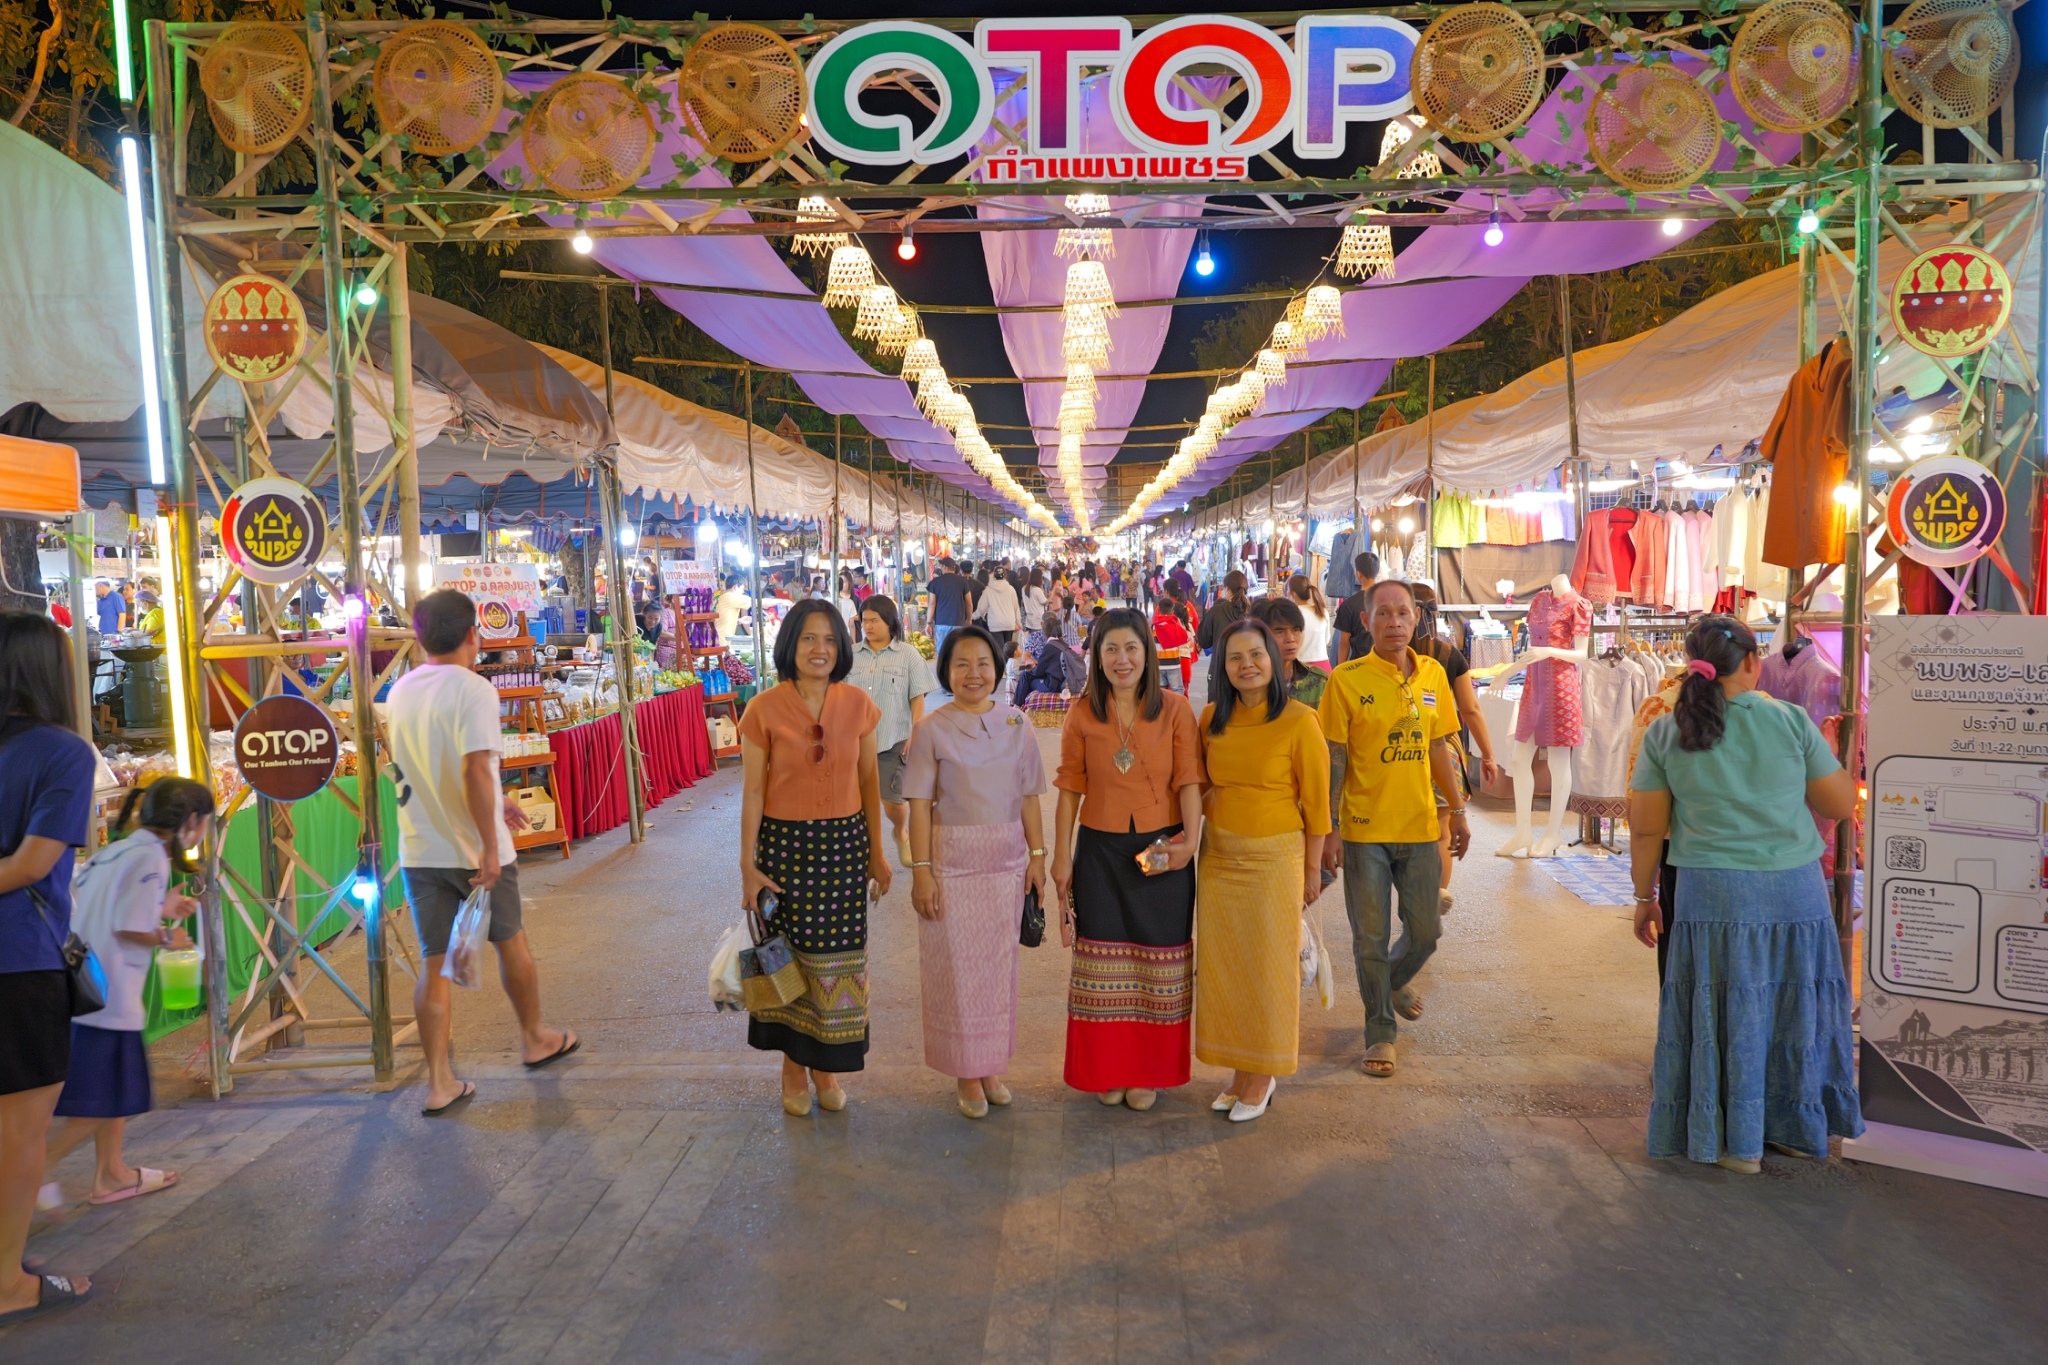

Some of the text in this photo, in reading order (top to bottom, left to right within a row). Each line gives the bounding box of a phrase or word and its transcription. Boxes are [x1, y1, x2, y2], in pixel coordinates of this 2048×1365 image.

[811, 22, 1416, 153] OTOP
[987, 149, 1244, 178] กำแพงเพชร
[1963, 716, 2017, 731] ประจำปี
[241, 728, 329, 757] OTOP
[1952, 737, 1975, 751] วันที่
[1980, 741, 2013, 753] 11-22
[244, 757, 331, 769] One Tambon One Product
[1352, 815, 1370, 825] true
[1893, 885, 1936, 897] zone 1
[2006, 929, 2039, 939] zone 2
